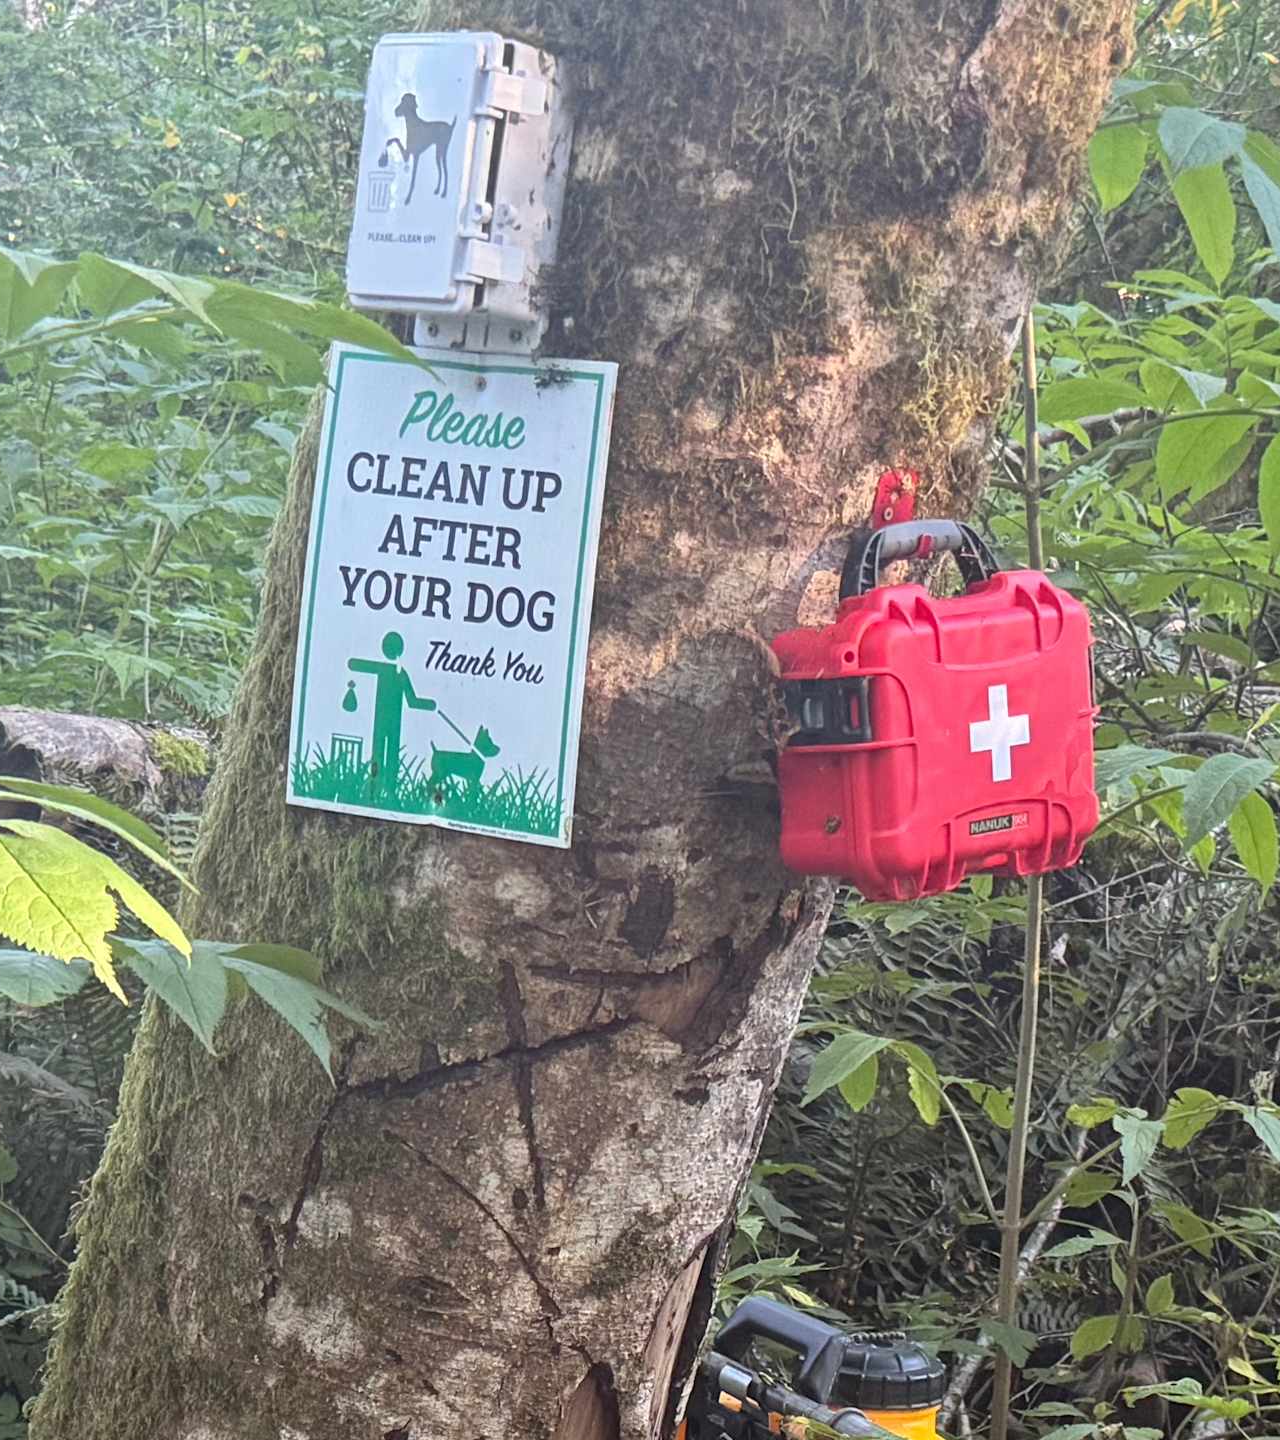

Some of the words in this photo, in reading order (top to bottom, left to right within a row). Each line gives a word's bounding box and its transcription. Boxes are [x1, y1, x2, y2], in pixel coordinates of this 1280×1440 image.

[399, 389, 526, 450] Please
[346, 451, 492, 506] CLEAN
[501, 467, 563, 513] UP
[378, 513, 522, 569] AFTER
[339, 566, 452, 621] YOUR
[463, 582, 556, 633] DOG
[425, 640, 497, 678] Thank
[502, 650, 545, 684] You
[970, 816, 1010, 834] NANUK
